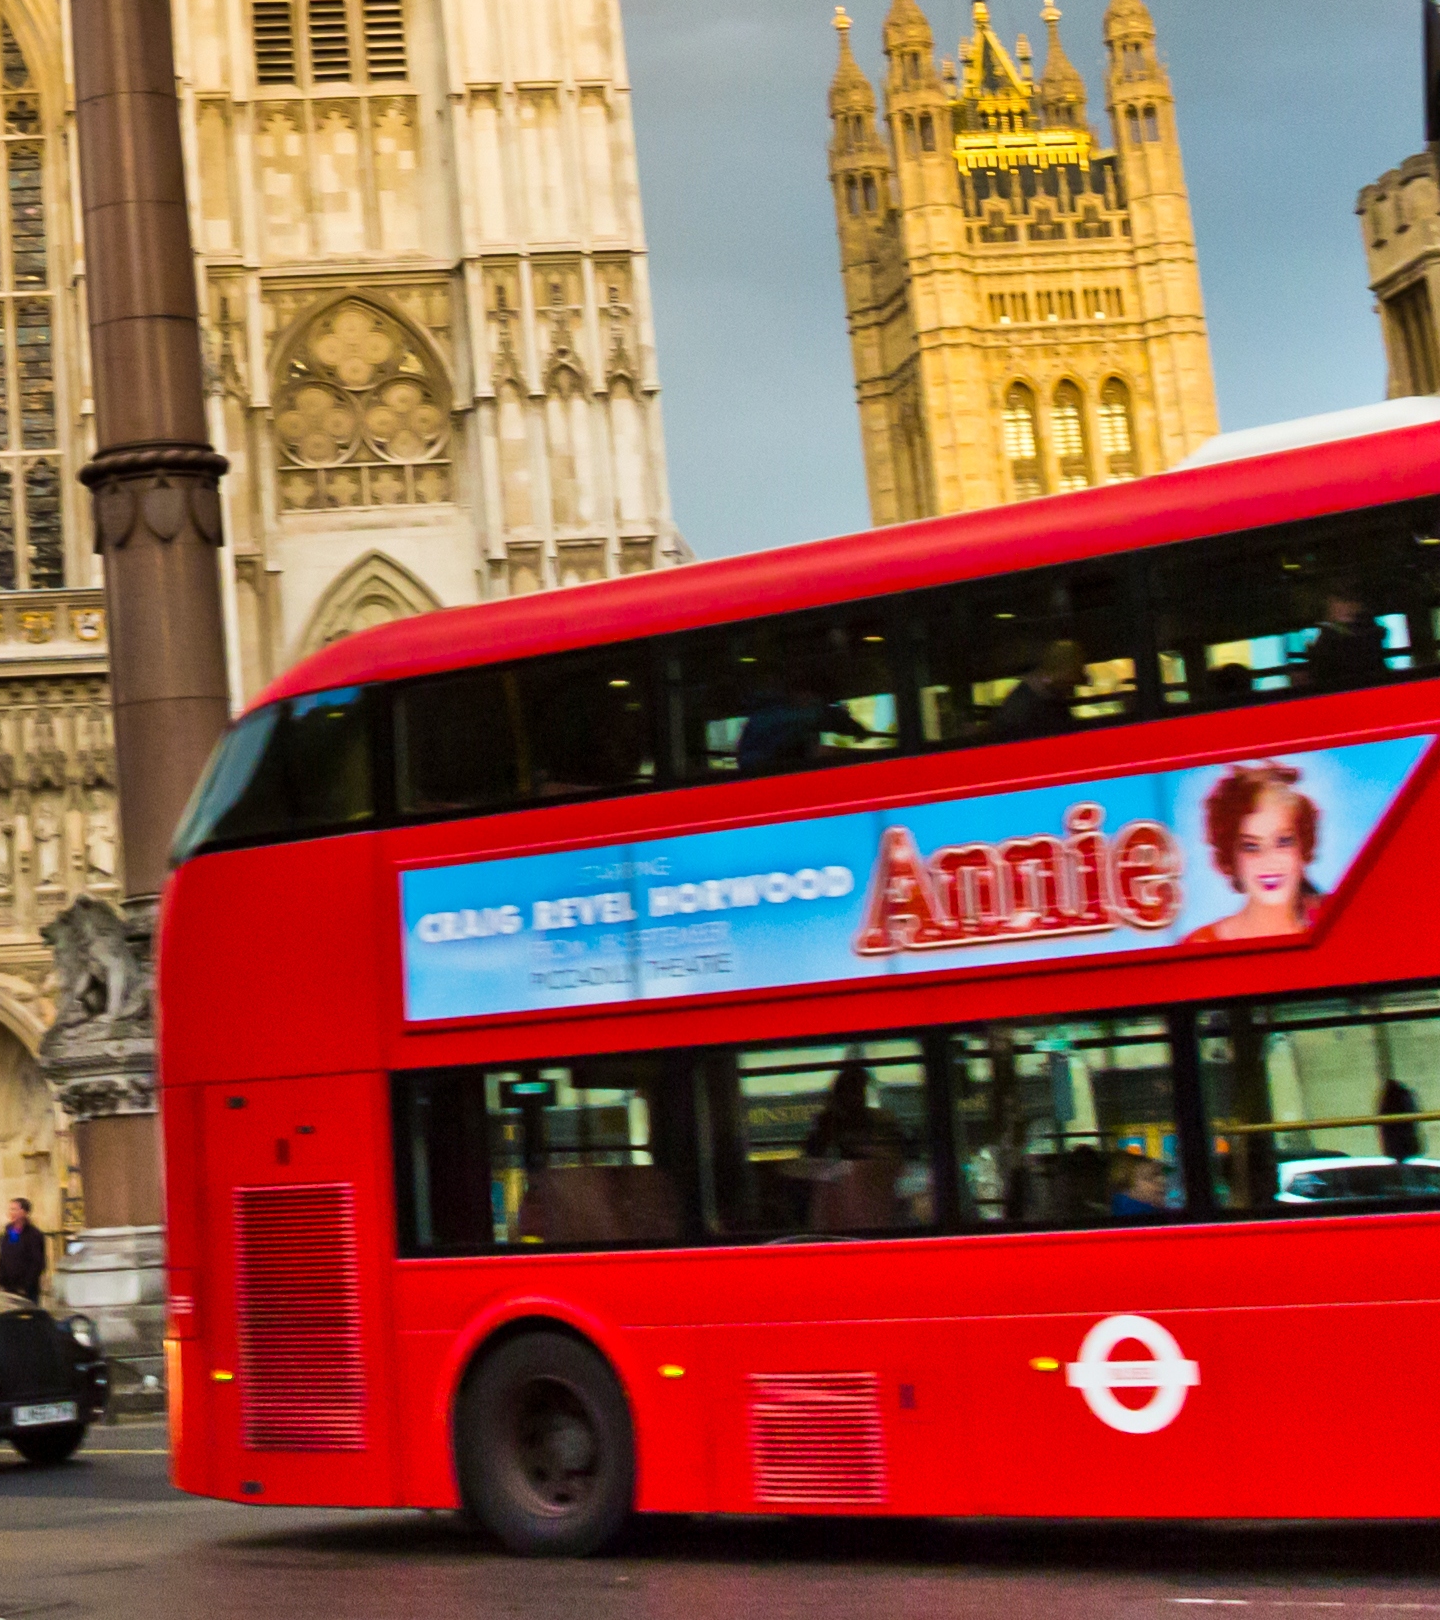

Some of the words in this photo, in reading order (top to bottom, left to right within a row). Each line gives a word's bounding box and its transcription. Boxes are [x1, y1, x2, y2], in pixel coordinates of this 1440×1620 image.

[415, 904, 523, 943] CRAIG
[531, 892, 638, 931] REVEL
[647, 866, 856, 918] HORWOOD
[851, 800, 1185, 958] Annie
